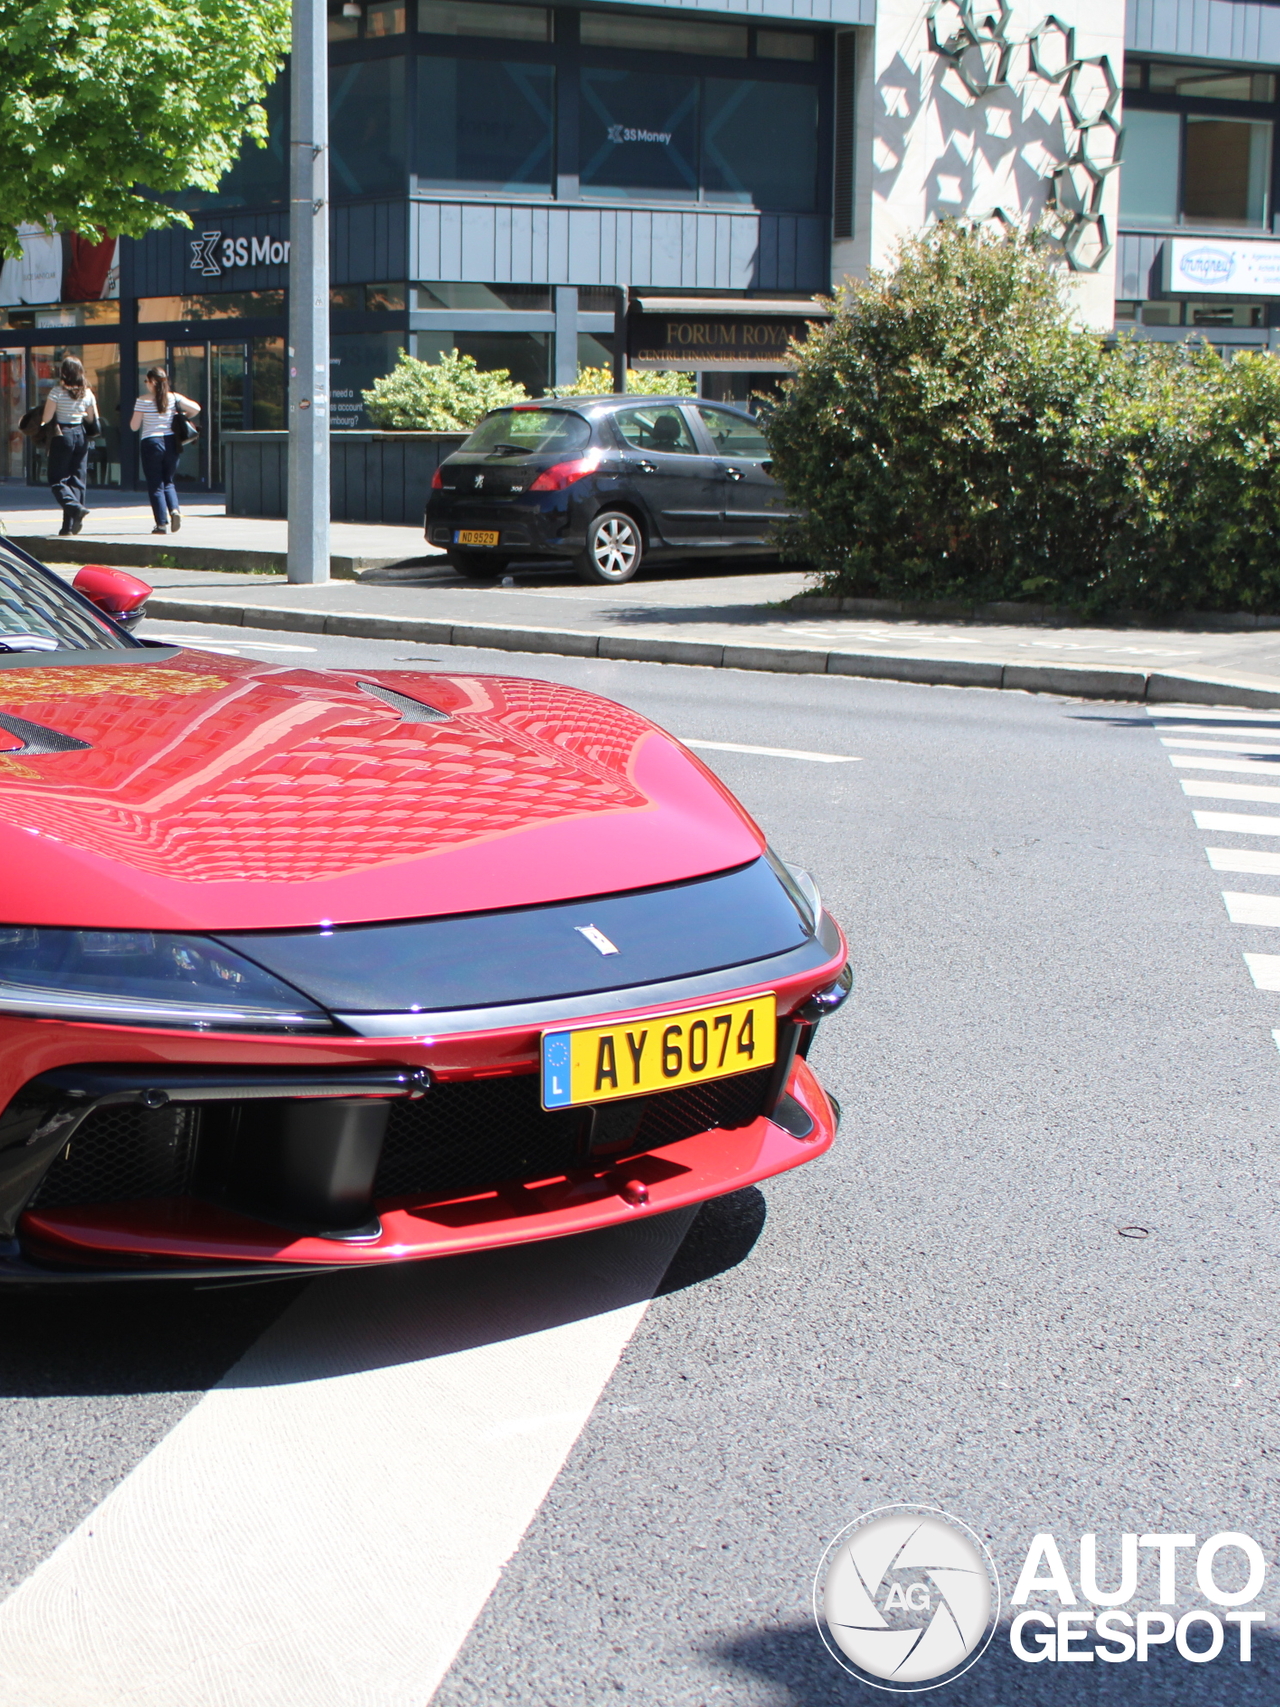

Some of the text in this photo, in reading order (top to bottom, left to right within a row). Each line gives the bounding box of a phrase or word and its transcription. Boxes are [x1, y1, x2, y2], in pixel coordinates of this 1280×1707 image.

[624, 128, 671, 146] 3S Money
[222, 237, 249, 268] 3S
[666, 322, 736, 345] FORUM
[638, 349, 680, 362] CENTRE
[681, 350, 736, 362] FINANCIER
[738, 351, 750, 362] ET
[332, 388, 348, 398] need
[337, 403, 363, 412] account
[330, 415, 359, 428] mbourg?
[462, 532, 495, 544] ND 9529
[593, 1008, 755, 1093] AY 6074
[552, 1075, 563, 1095] L
